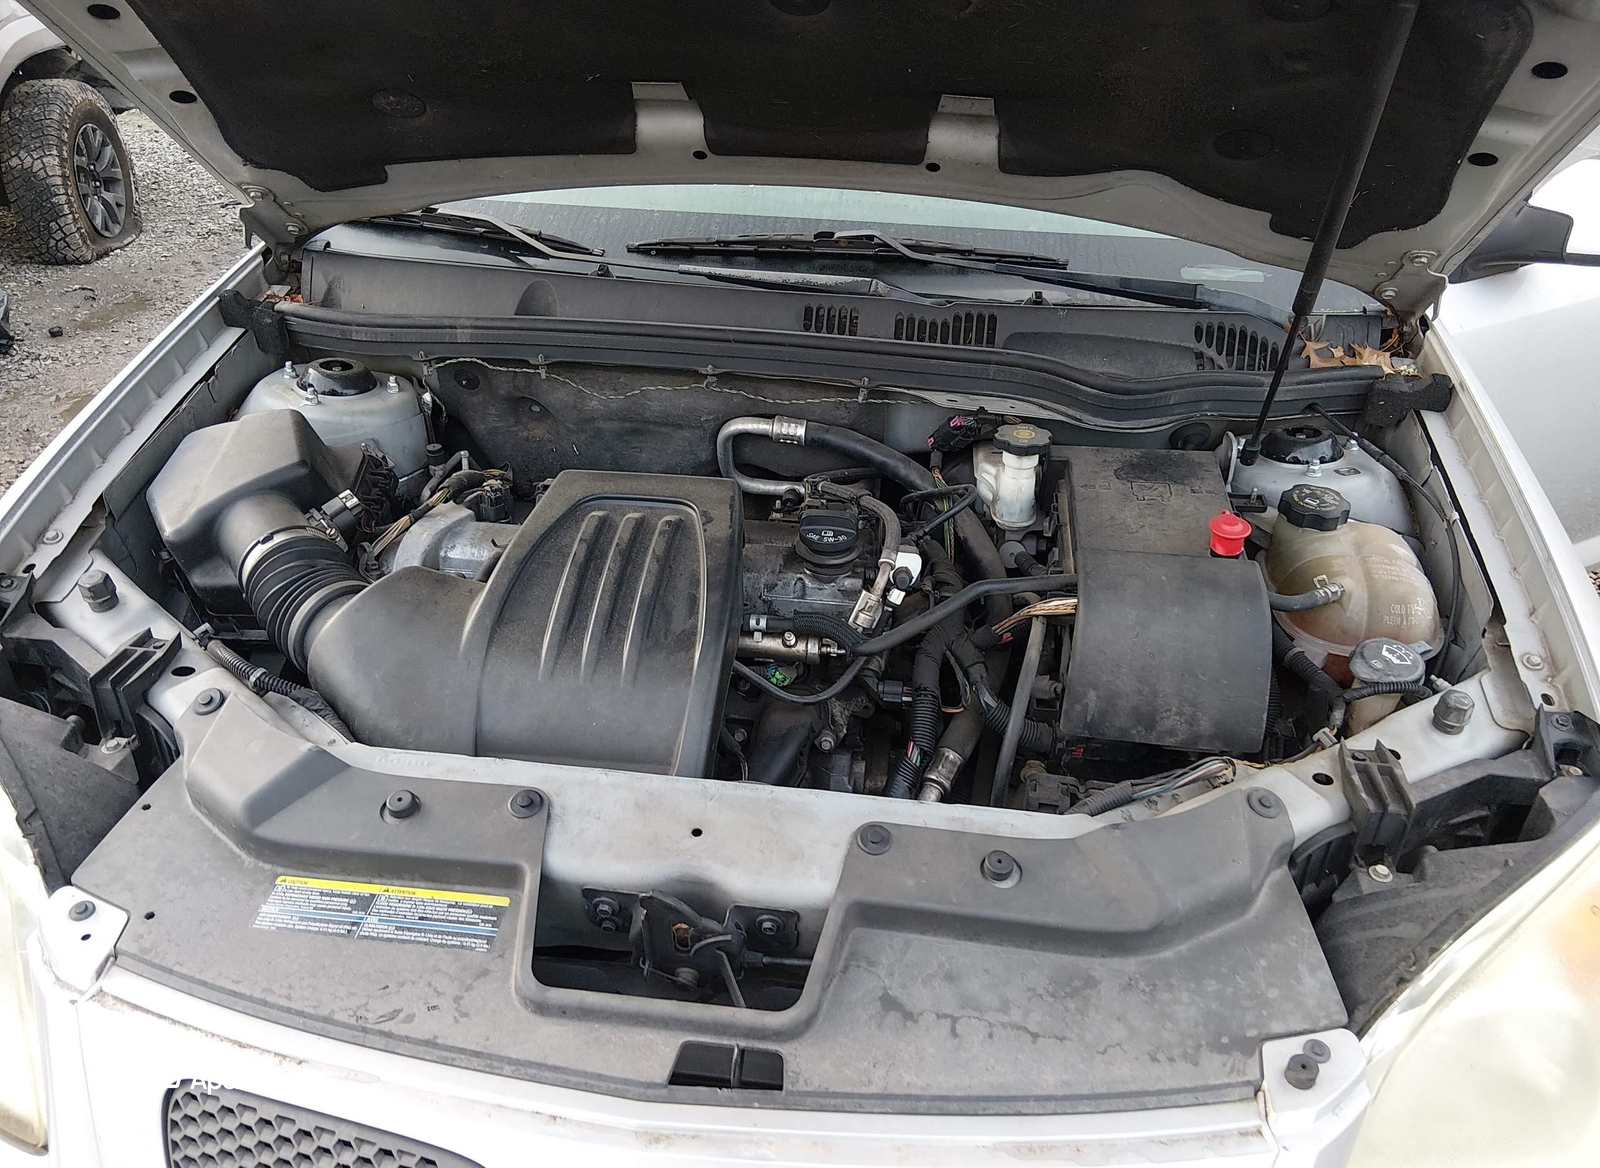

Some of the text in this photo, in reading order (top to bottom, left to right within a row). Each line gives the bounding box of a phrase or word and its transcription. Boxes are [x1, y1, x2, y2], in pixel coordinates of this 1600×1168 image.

[806, 532, 848, 543] SAE 5W-30
[1390, 603, 1406, 615] COLD
[388, 888, 416, 896] ATTENTION
